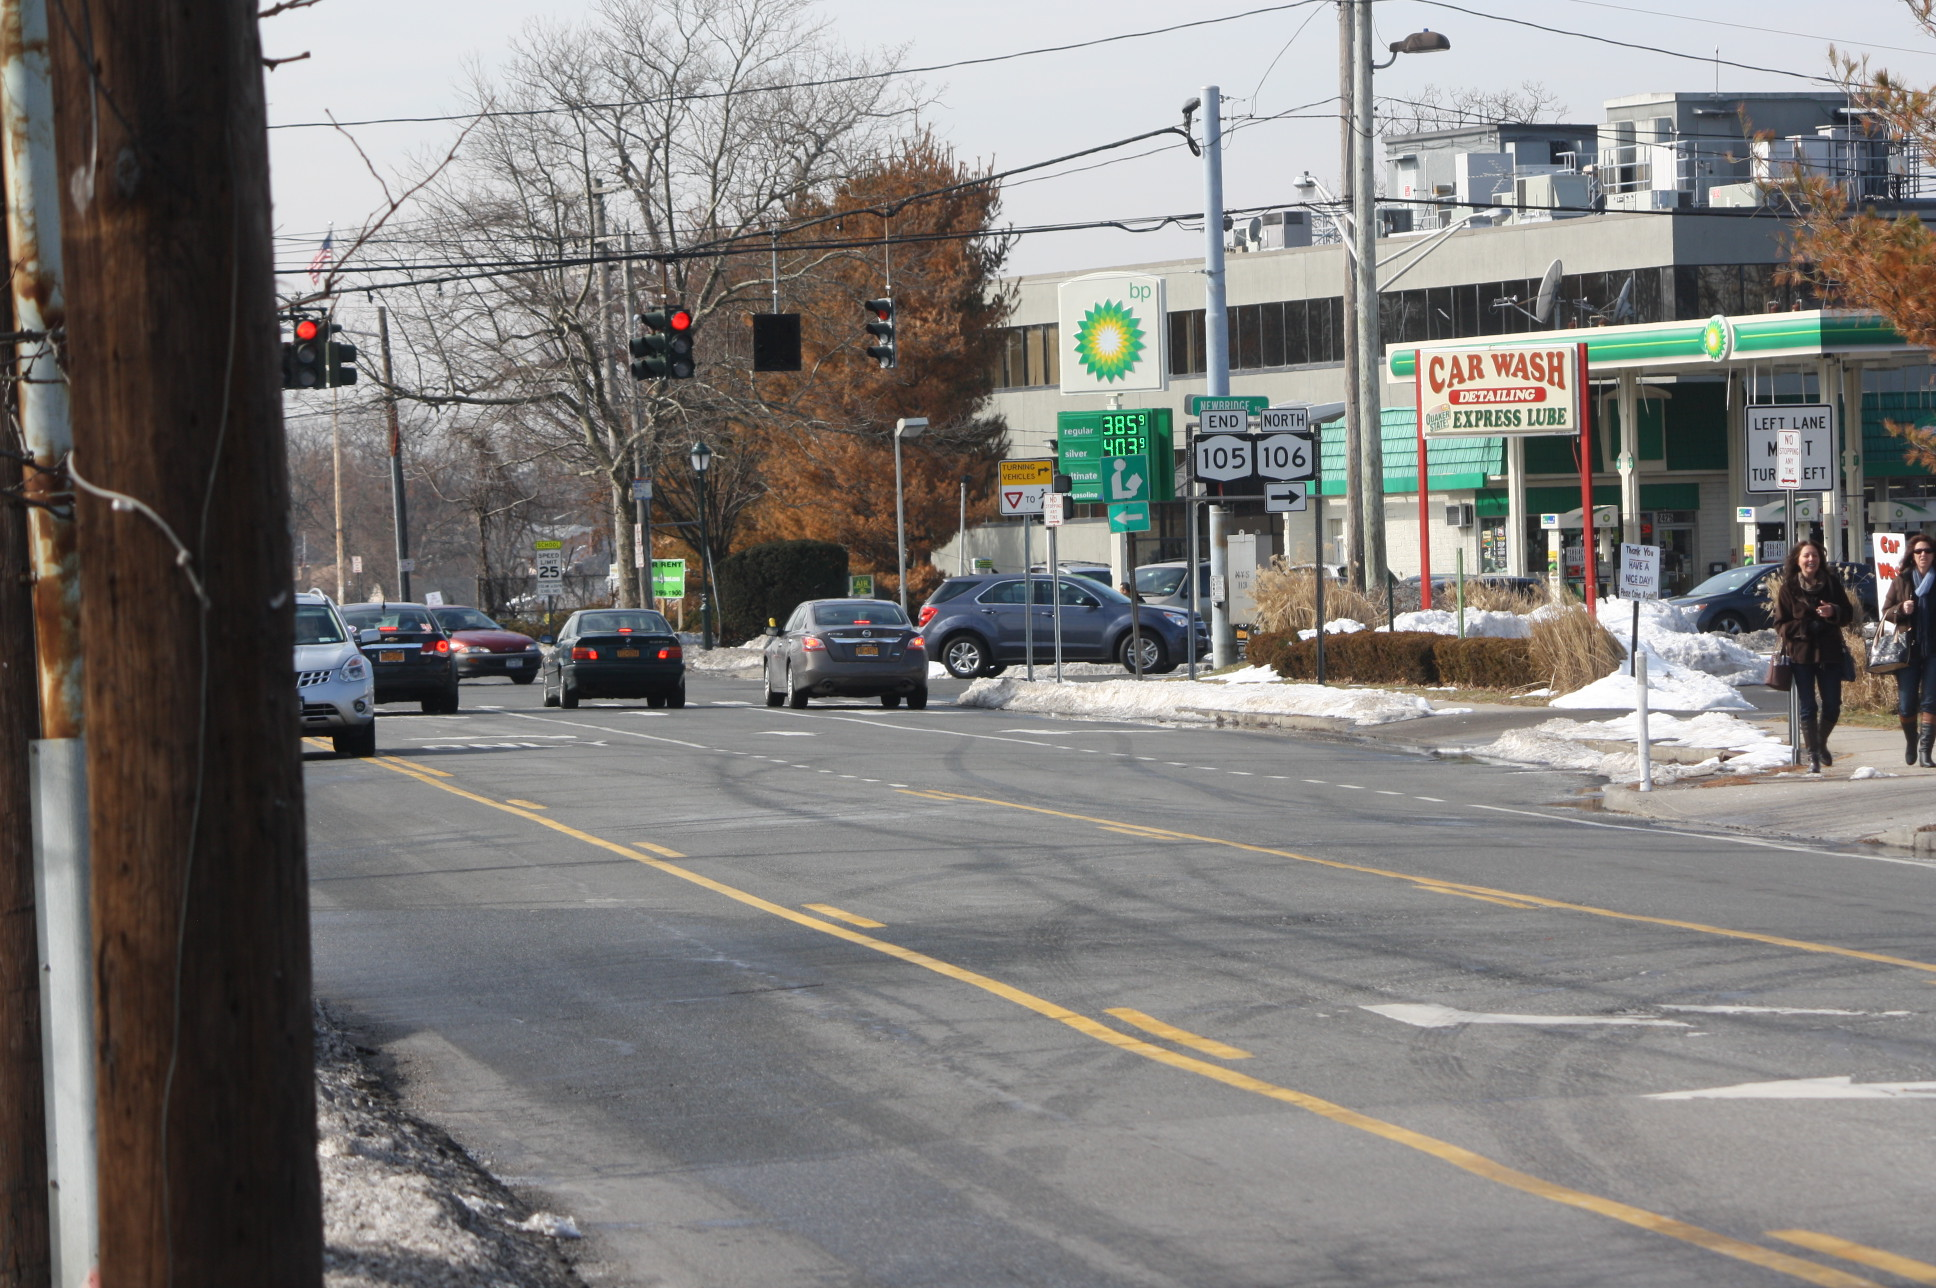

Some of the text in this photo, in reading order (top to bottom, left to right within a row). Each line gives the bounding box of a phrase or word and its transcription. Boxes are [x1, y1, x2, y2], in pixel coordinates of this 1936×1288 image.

[1130, 282, 1151, 302] bp
[1428, 351, 1566, 394] CAR WASH
[1458, 388, 1536, 403] DETAILING
[1200, 400, 1250, 412] NEWBRIDGE
[1209, 415, 1239, 428] END
[1264, 414, 1304, 427] NORTH
[1426, 410, 1450, 425] QUAKER
[1452, 407, 1567, 428] EXPRESS LUBE
[1754, 416, 1826, 430] LEFT LANE
[1064, 428, 1094, 436] regular
[1785, 435, 1793, 445] NO
[1768, 440, 1813, 457] MT
[1203, 448, 1246, 469] 105
[1264, 446, 1306, 468] 106
[1752, 467, 1826, 481] TUR EFT
[1626, 546, 1641, 557] Thank
[1880, 536, 1900, 554] Car
[539, 566, 559, 578] 25
[1629, 561, 1642, 570] HAVE
[1626, 574, 1638, 583] NICE
